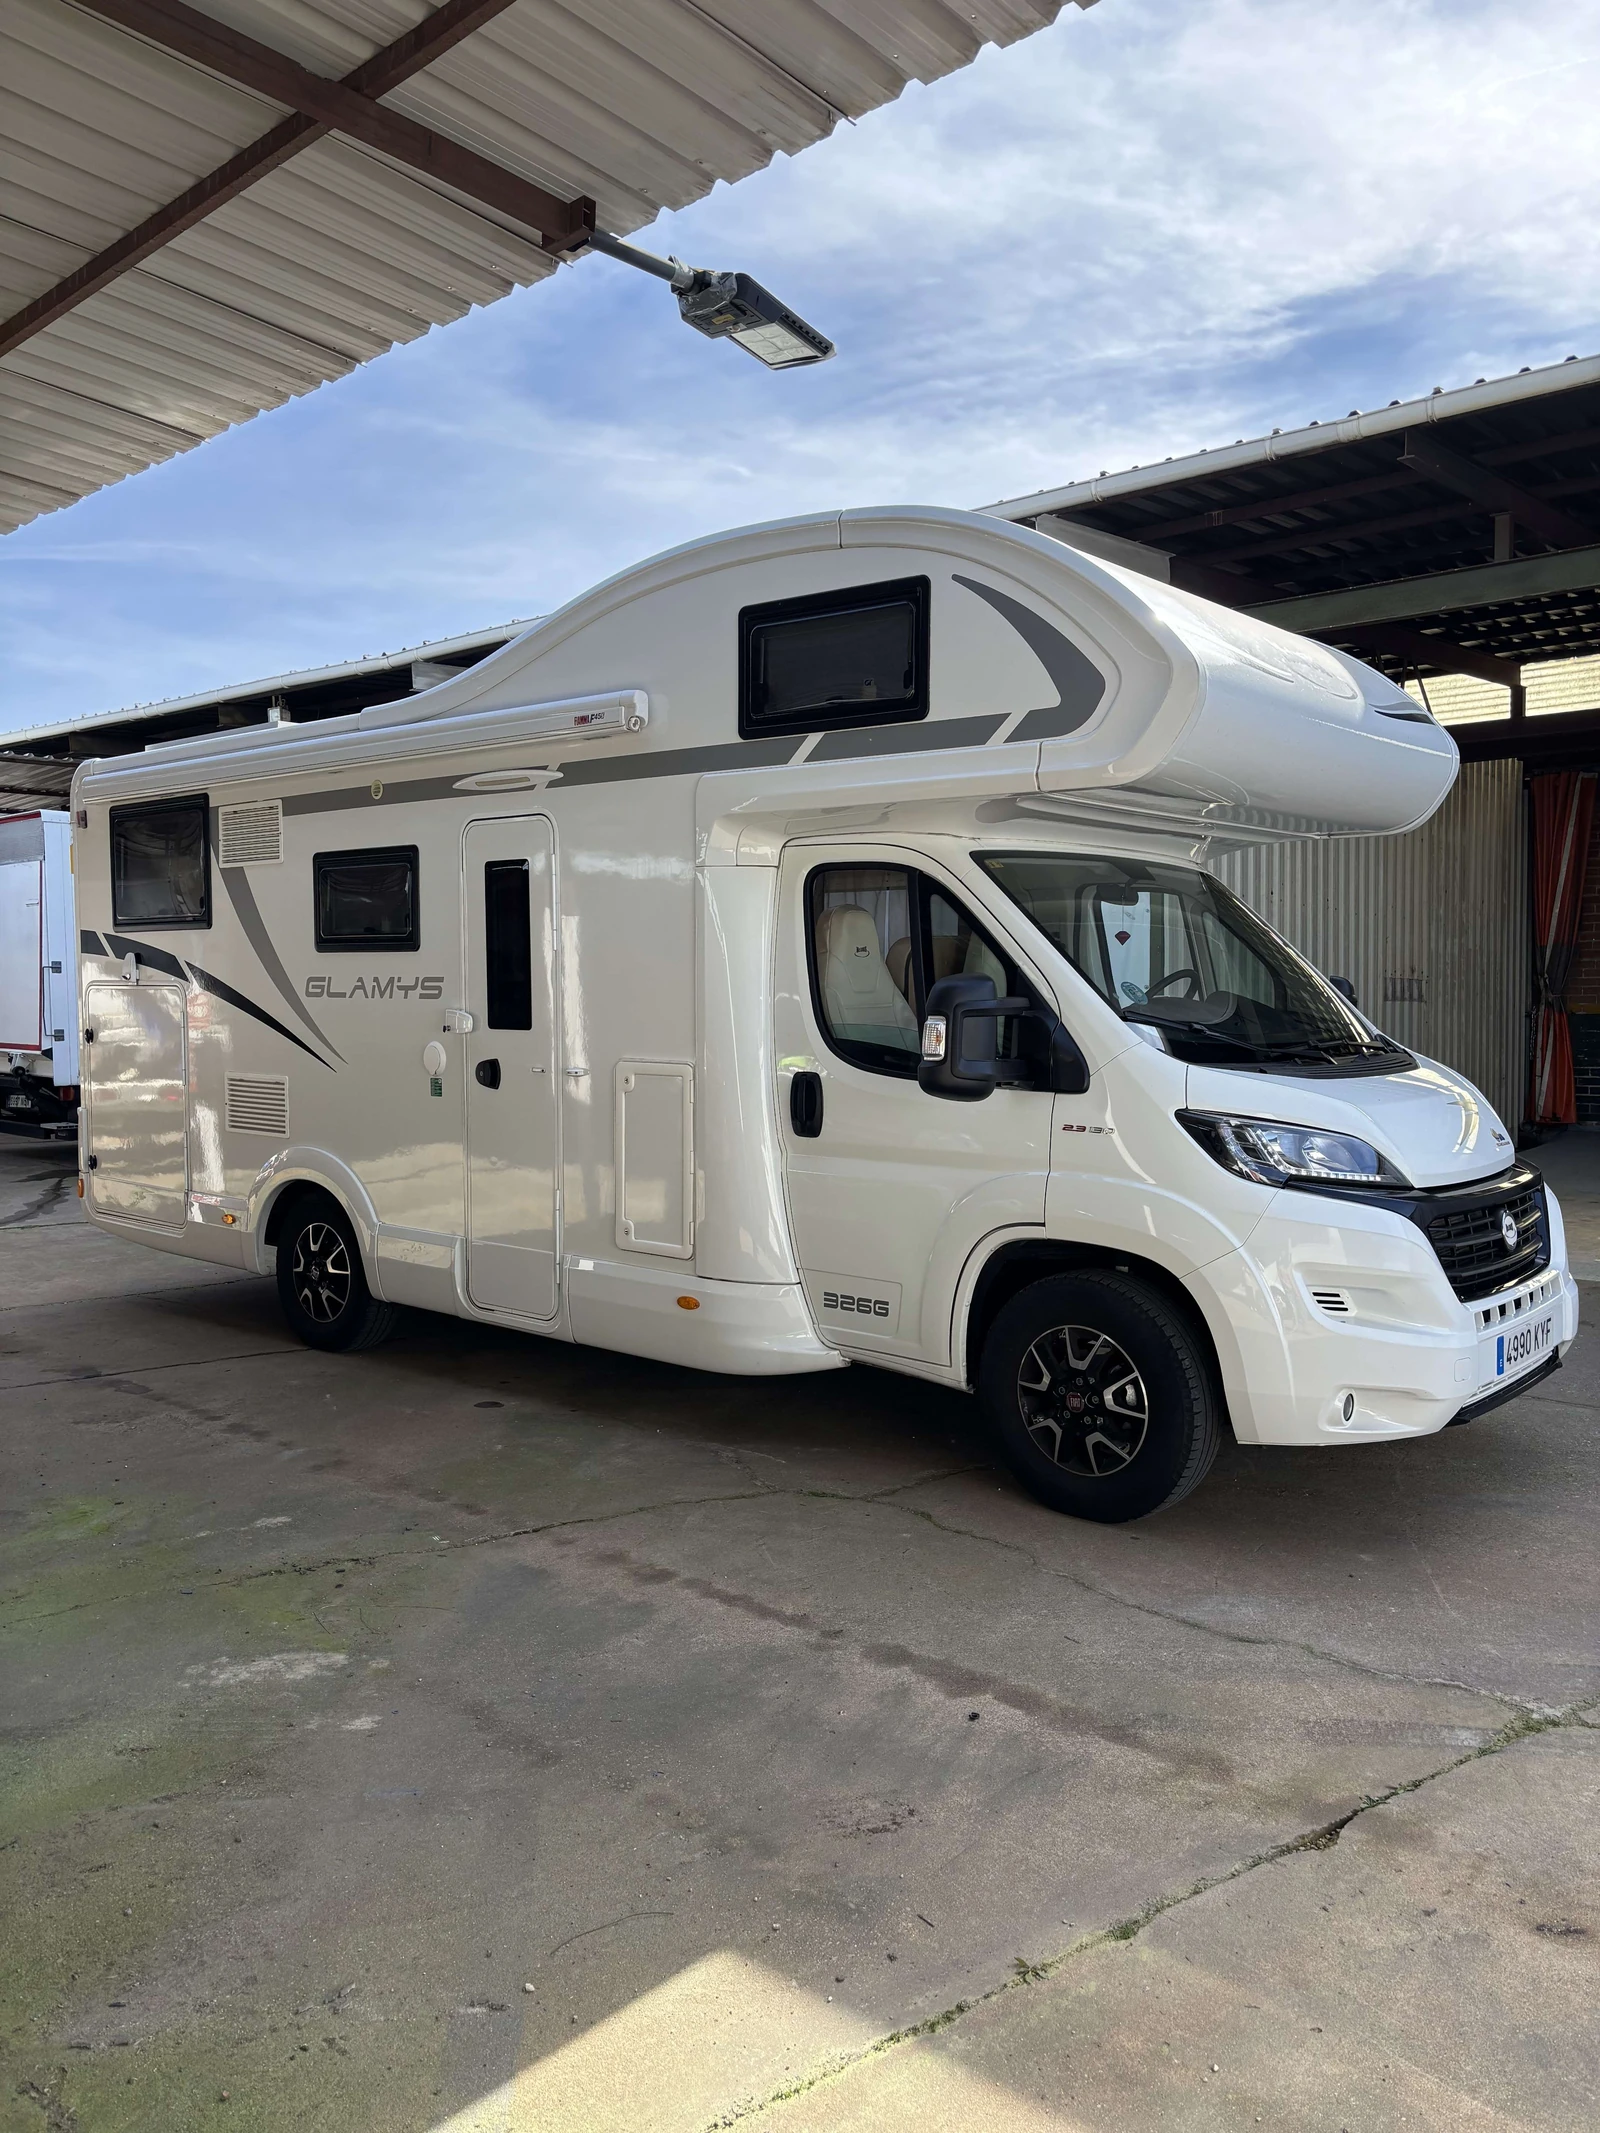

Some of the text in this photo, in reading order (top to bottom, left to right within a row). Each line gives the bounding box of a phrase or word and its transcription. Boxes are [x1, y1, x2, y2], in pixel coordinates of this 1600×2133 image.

[304, 976, 445, 1000] GLAMYS
[823, 1291, 890, 1318] 326G
[1506, 1317, 1552, 1365] 4990 KYF
